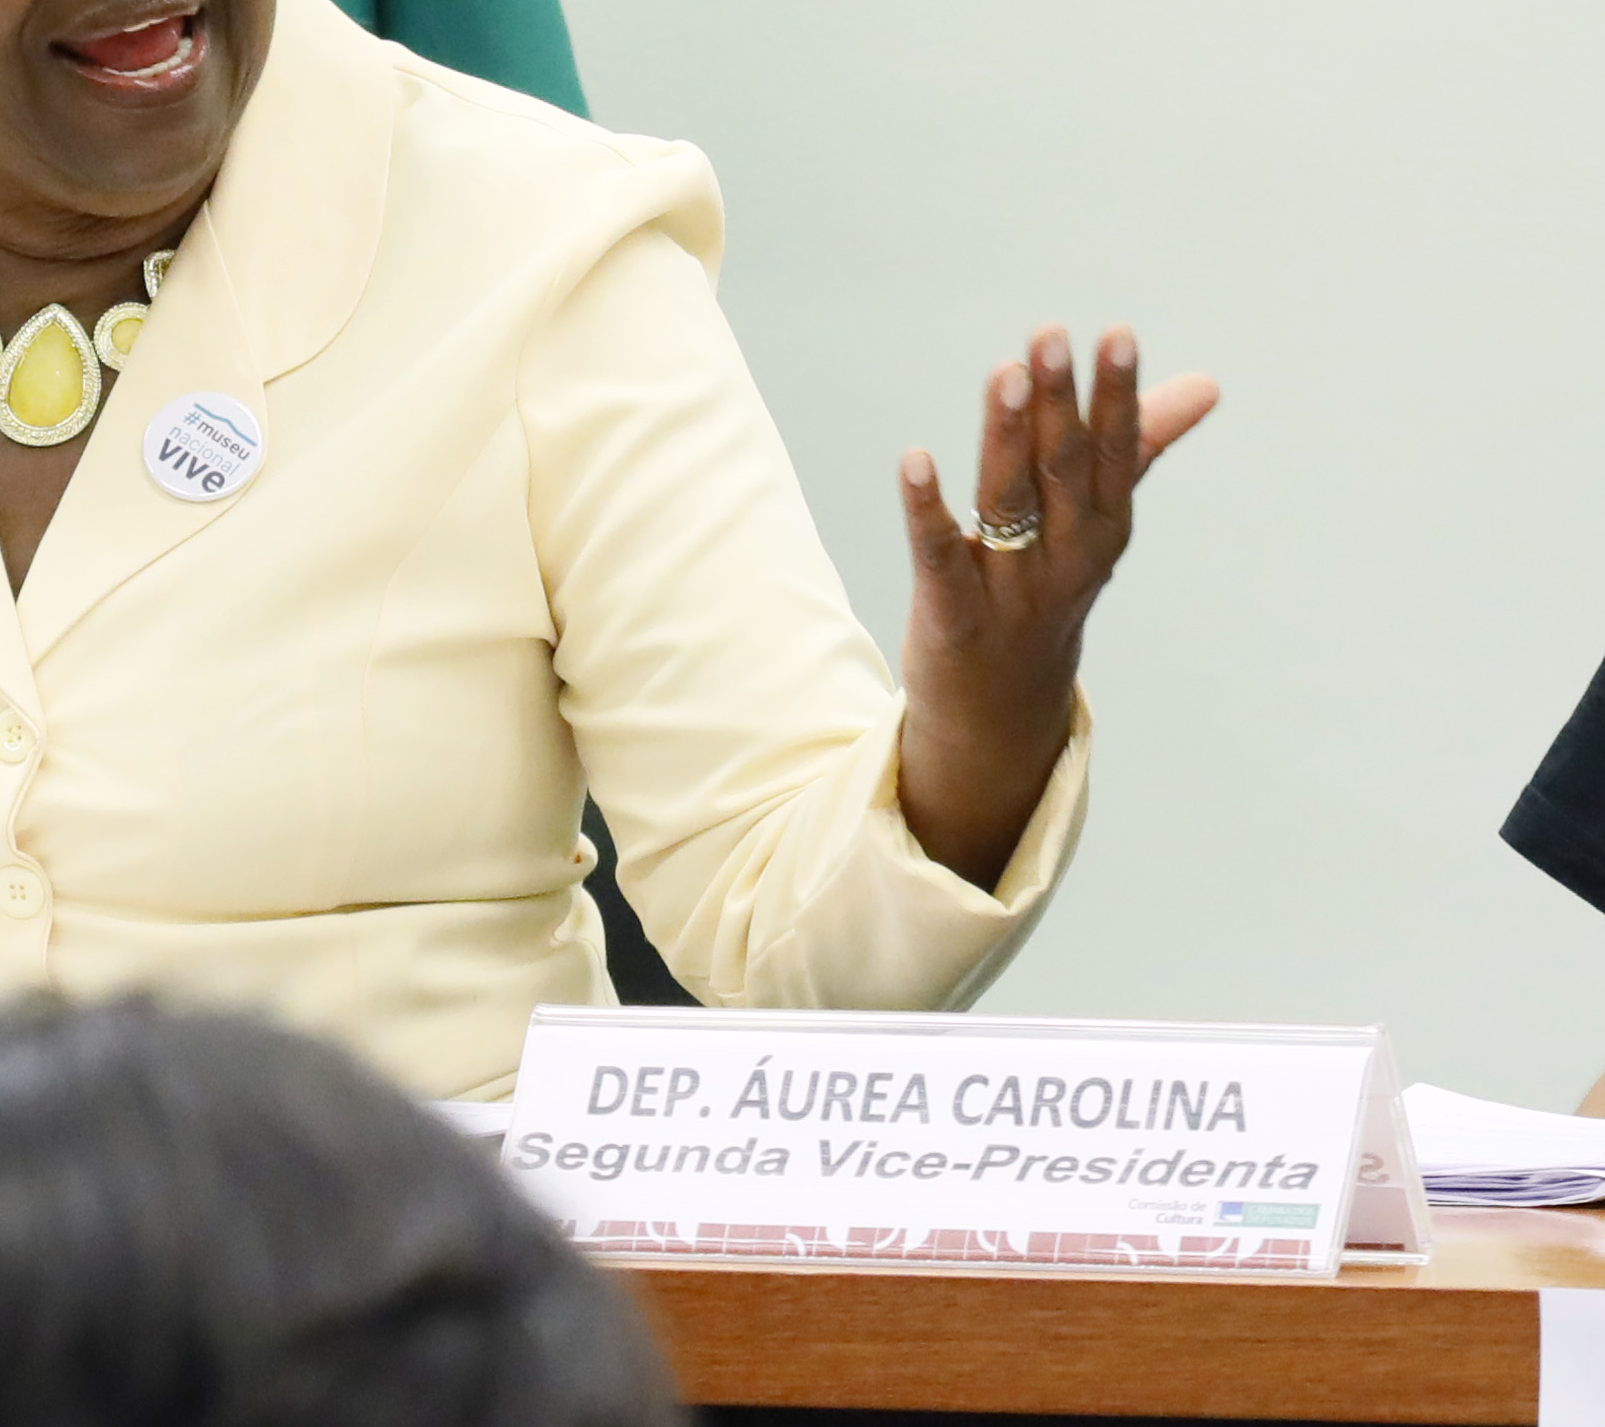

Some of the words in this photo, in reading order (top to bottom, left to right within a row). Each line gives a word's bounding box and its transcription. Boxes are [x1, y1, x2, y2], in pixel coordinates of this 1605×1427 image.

[169, 425, 240, 475] nacional
[183, 410, 250, 461] #museu
[157, 438, 226, 493] vive
[587, 1066, 710, 1119] DEP.
[731, 1054, 931, 1126] ÁUREA
[951, 1075, 1247, 1133] CAROLINA
[511, 1131, 790, 1181] Segunda
[817, 1138, 1321, 1192] Vice-Presidenta
[1156, 1212, 1204, 1225] Cultura
[1192, 1200, 1205, 1212] de
